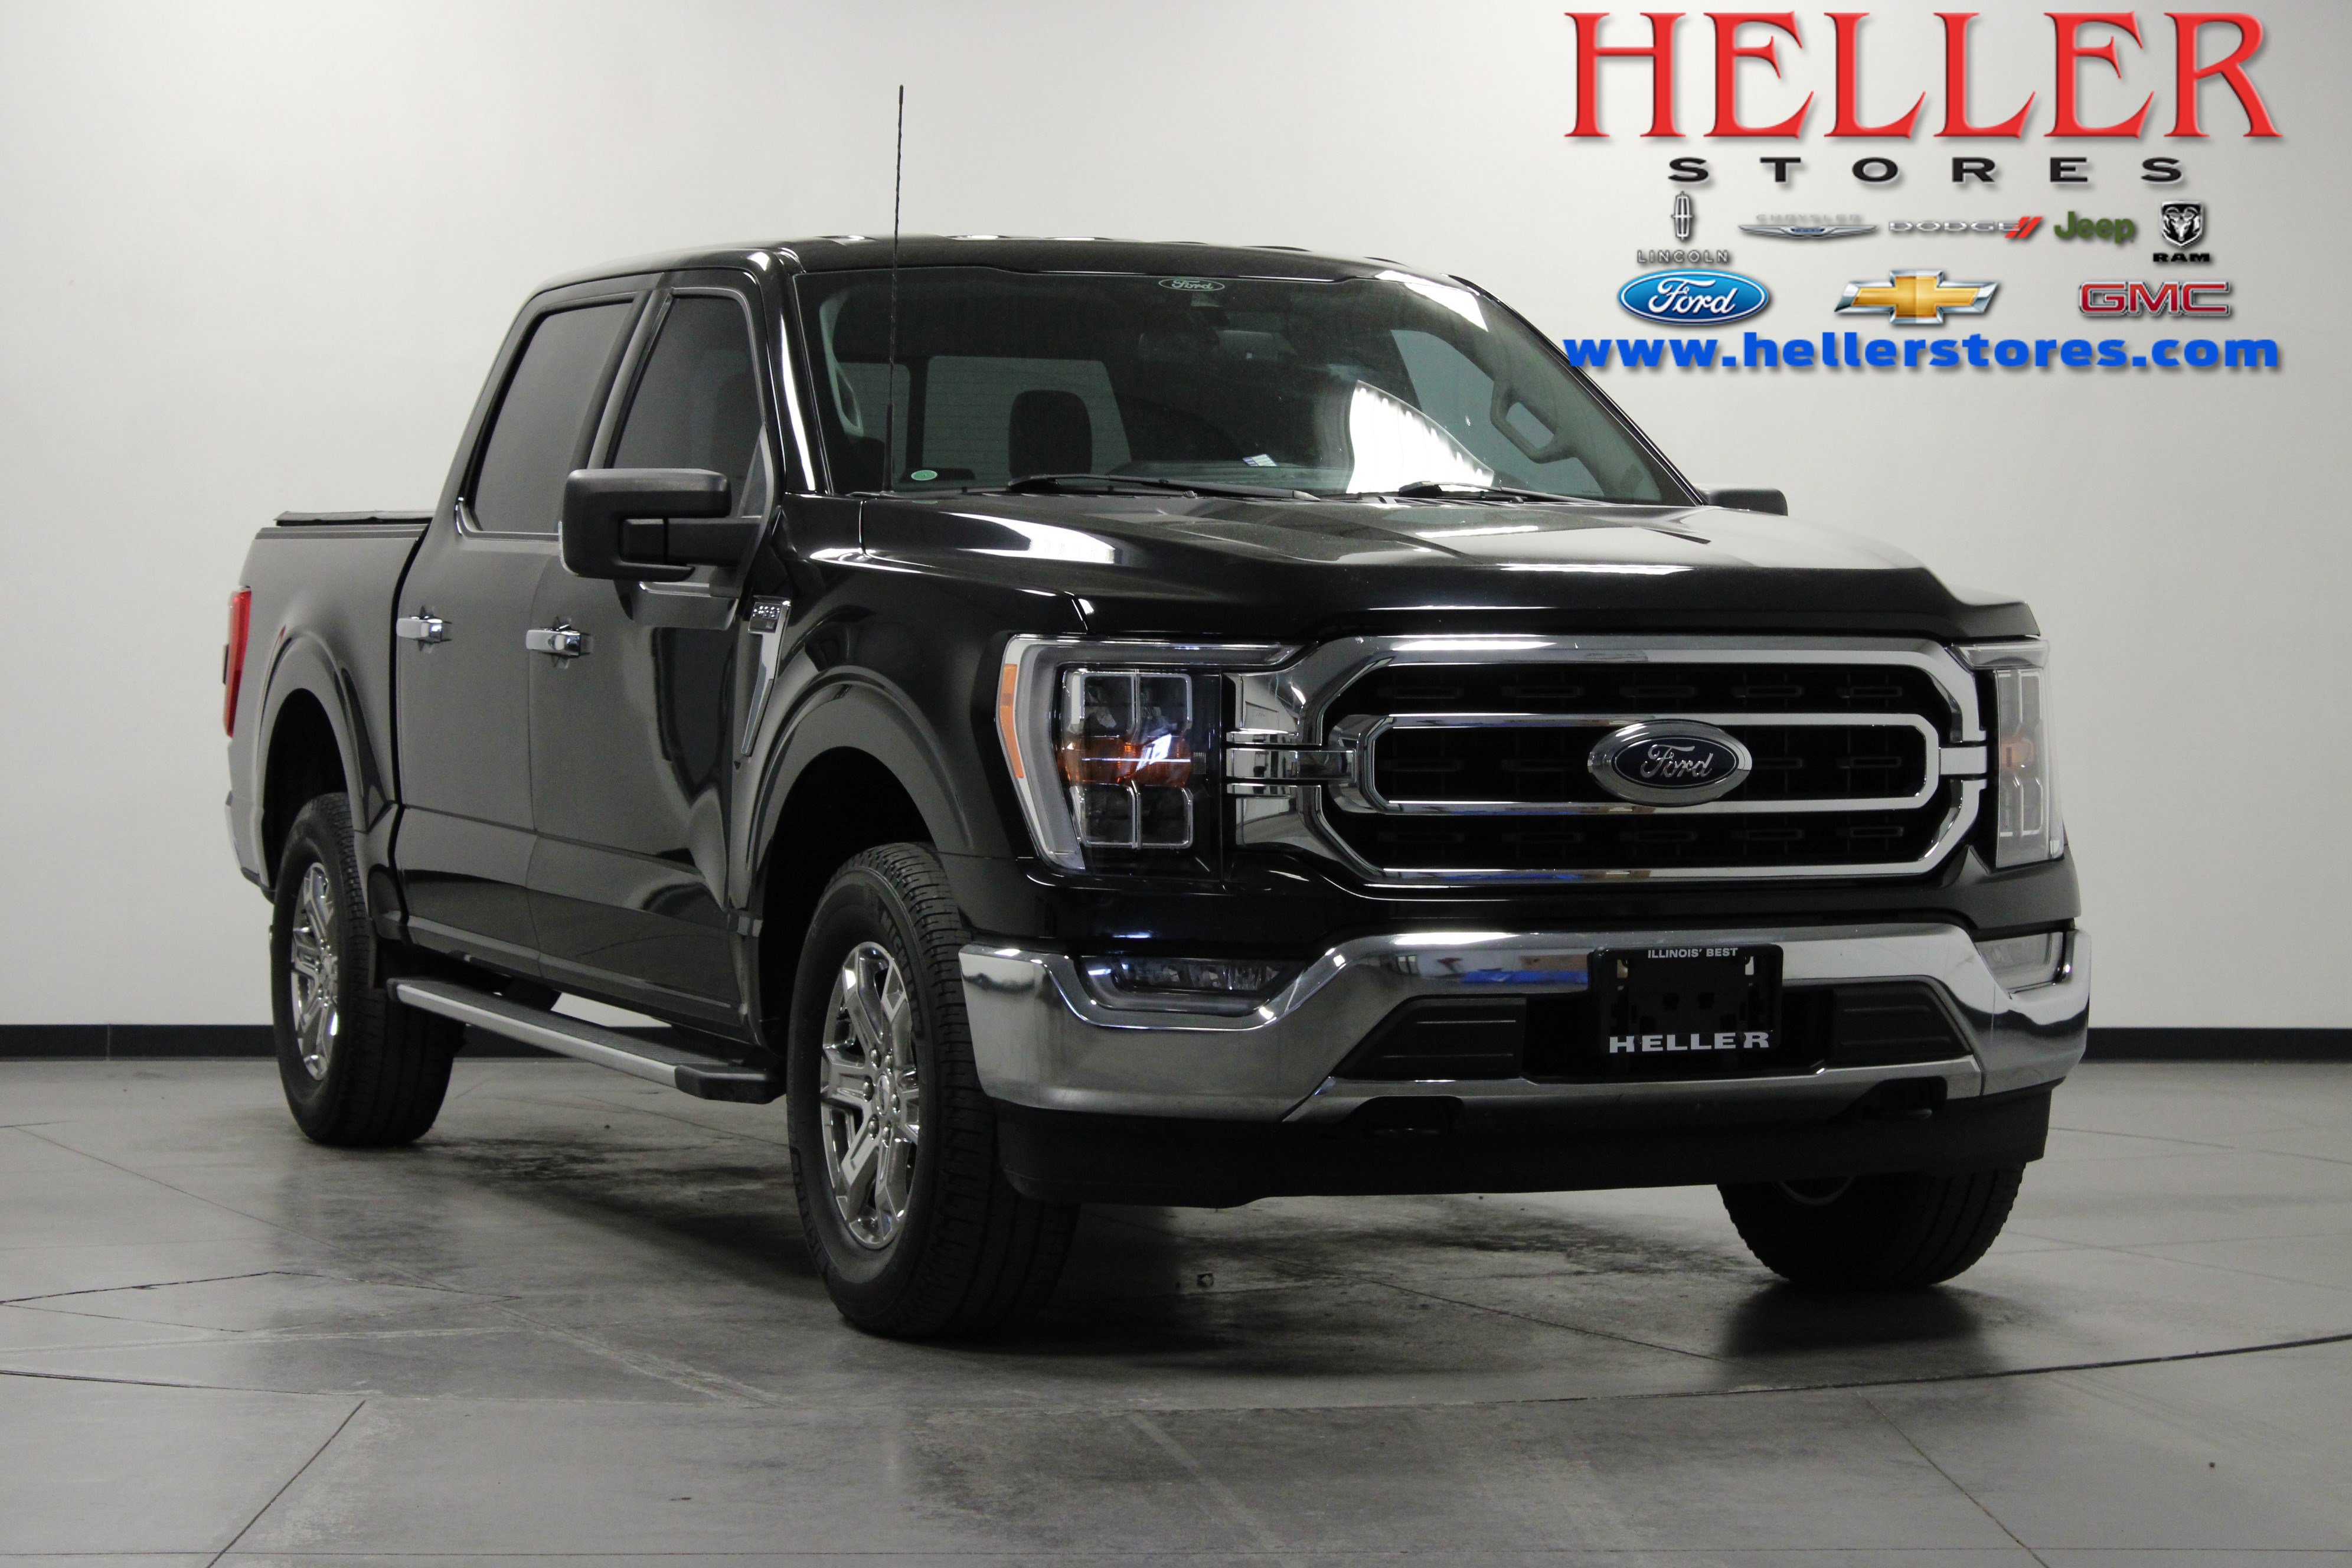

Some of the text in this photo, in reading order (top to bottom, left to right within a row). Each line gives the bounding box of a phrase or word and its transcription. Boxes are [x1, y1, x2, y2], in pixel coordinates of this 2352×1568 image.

[1171, 279, 1214, 290] Ford
[1639, 744, 1714, 778] Ford
[1706, 948, 1739, 957] BEST
[880, 910, 922, 1033] MICHELIN
[1609, 1031, 1770, 1053] HELLER
